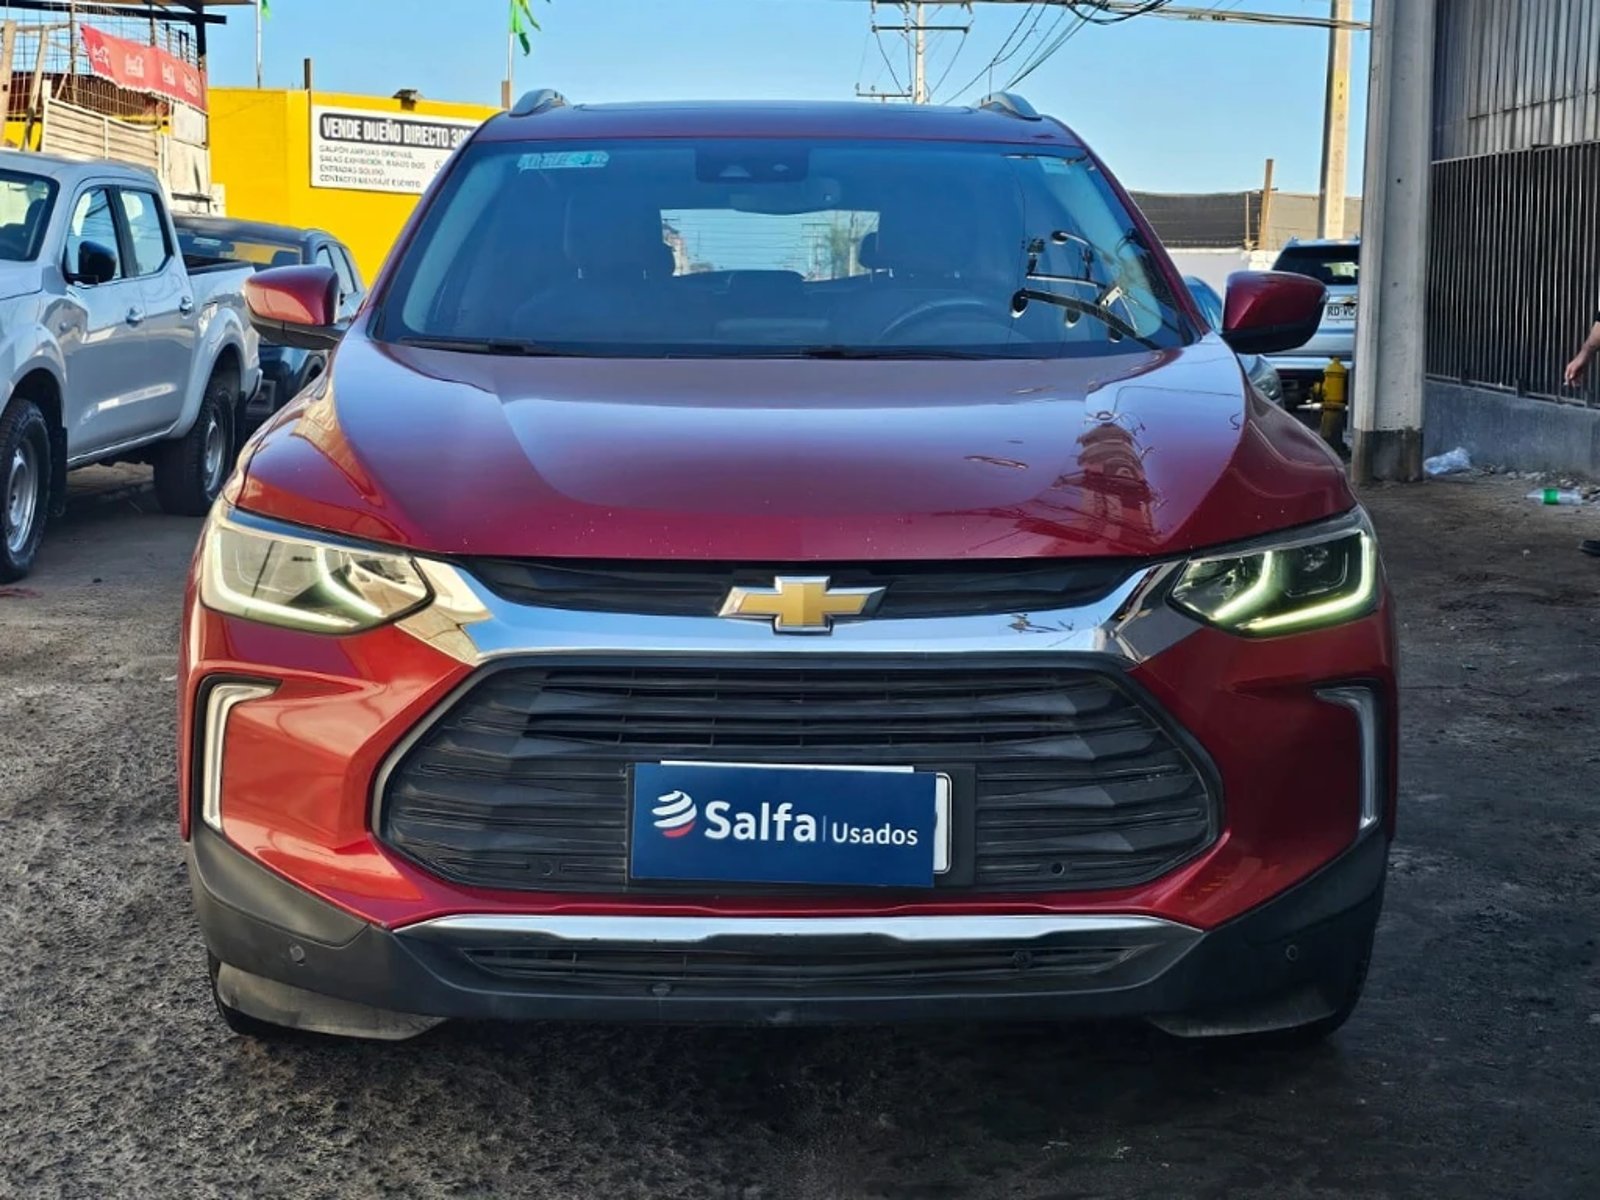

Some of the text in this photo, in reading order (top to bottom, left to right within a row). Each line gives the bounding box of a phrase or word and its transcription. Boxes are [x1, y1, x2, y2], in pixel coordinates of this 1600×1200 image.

[322, 116, 361, 139] VENDE
[363, 119, 401, 143] DUEÑO
[403, 124, 448, 147] DIRECTO
[704, 800, 918, 846] Salfa Usados
